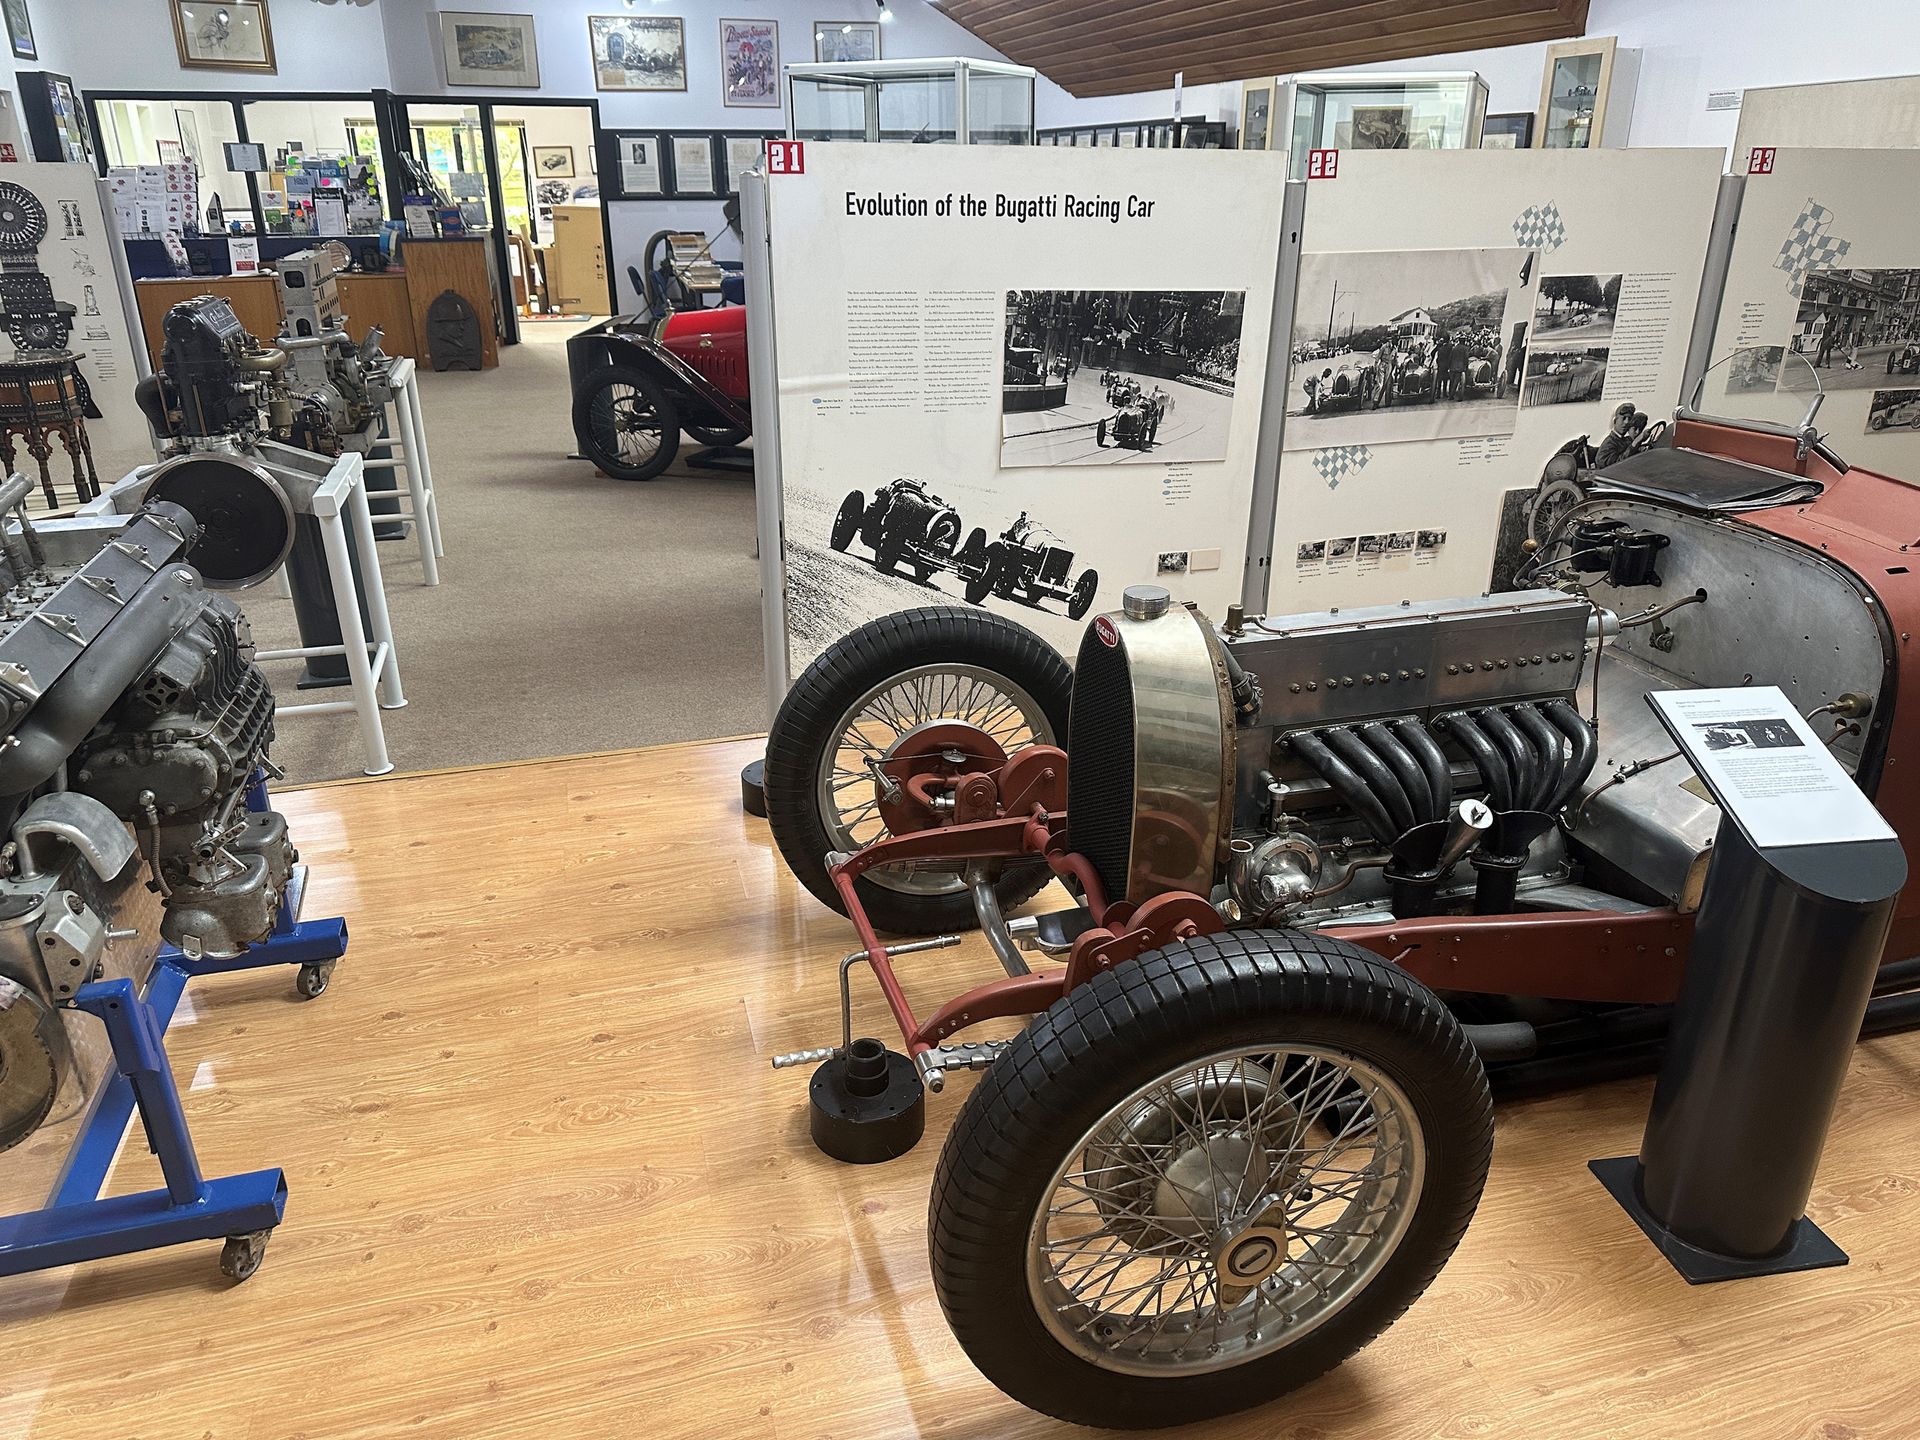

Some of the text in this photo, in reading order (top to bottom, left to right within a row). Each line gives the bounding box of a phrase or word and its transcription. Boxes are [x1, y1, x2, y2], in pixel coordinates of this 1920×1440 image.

[771, 144, 800, 171] 21
[1311, 152, 1337, 176] 22
[1750, 150, 1774, 171] 23
[846, 191, 1156, 224] Evolution of the Bugatti Racing Car
[933, 520, 955, 550] 2
